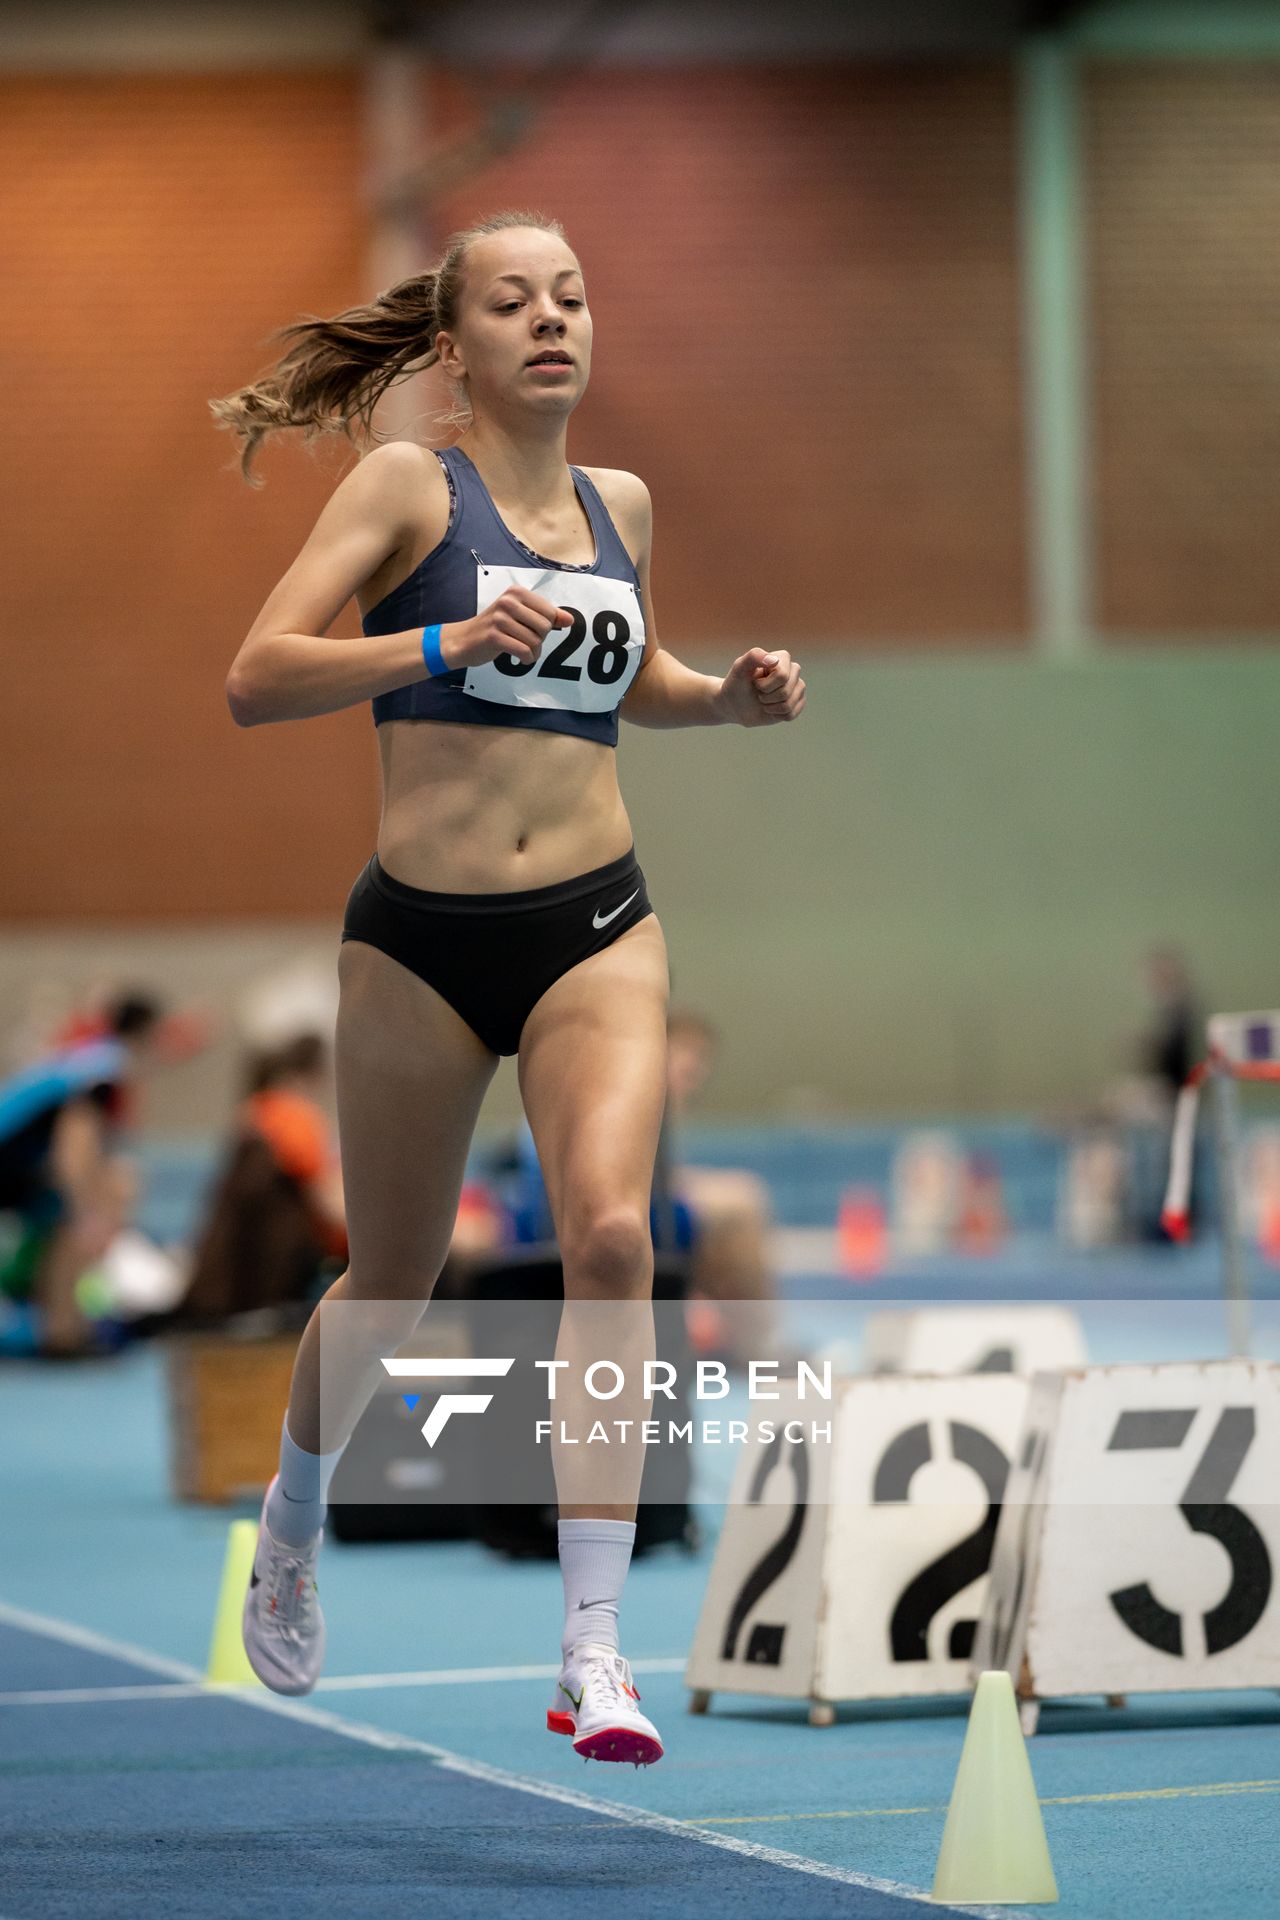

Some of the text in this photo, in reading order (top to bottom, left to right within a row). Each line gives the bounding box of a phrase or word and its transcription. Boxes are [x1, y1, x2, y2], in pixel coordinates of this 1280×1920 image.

[721, 1422, 809, 1666] 2
[872, 1420, 1011, 1662] 2
[1106, 1407, 1272, 1657] 3
